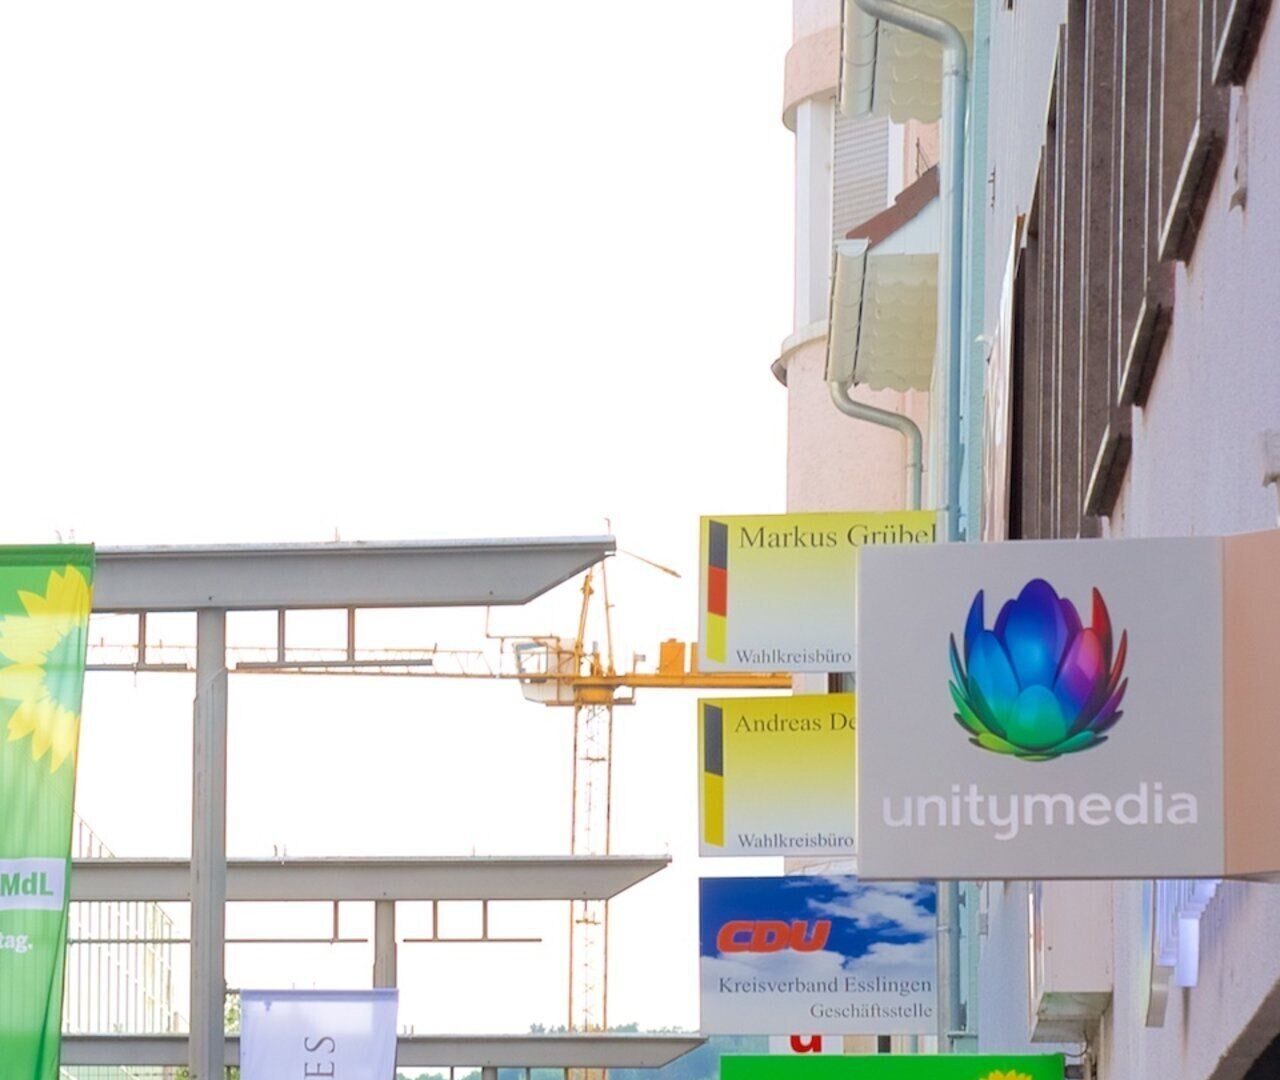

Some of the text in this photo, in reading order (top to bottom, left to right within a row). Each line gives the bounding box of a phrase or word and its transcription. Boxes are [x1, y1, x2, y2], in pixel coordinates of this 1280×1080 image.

[739, 523, 937, 549] Markus Grübel
[736, 648, 852, 665] Wahlkreisbüro
[735, 712, 822, 734] Andreas
[881, 783, 1199, 840] unitymedia
[737, 833, 854, 850] Wahlkreisbüro
[0, 873, 54, 898] MdL
[716, 919, 832, 953] CDU
[718, 976, 932, 998] Kreisverband Esslingen
[810, 1002, 933, 1021] Geschäftsstelle
